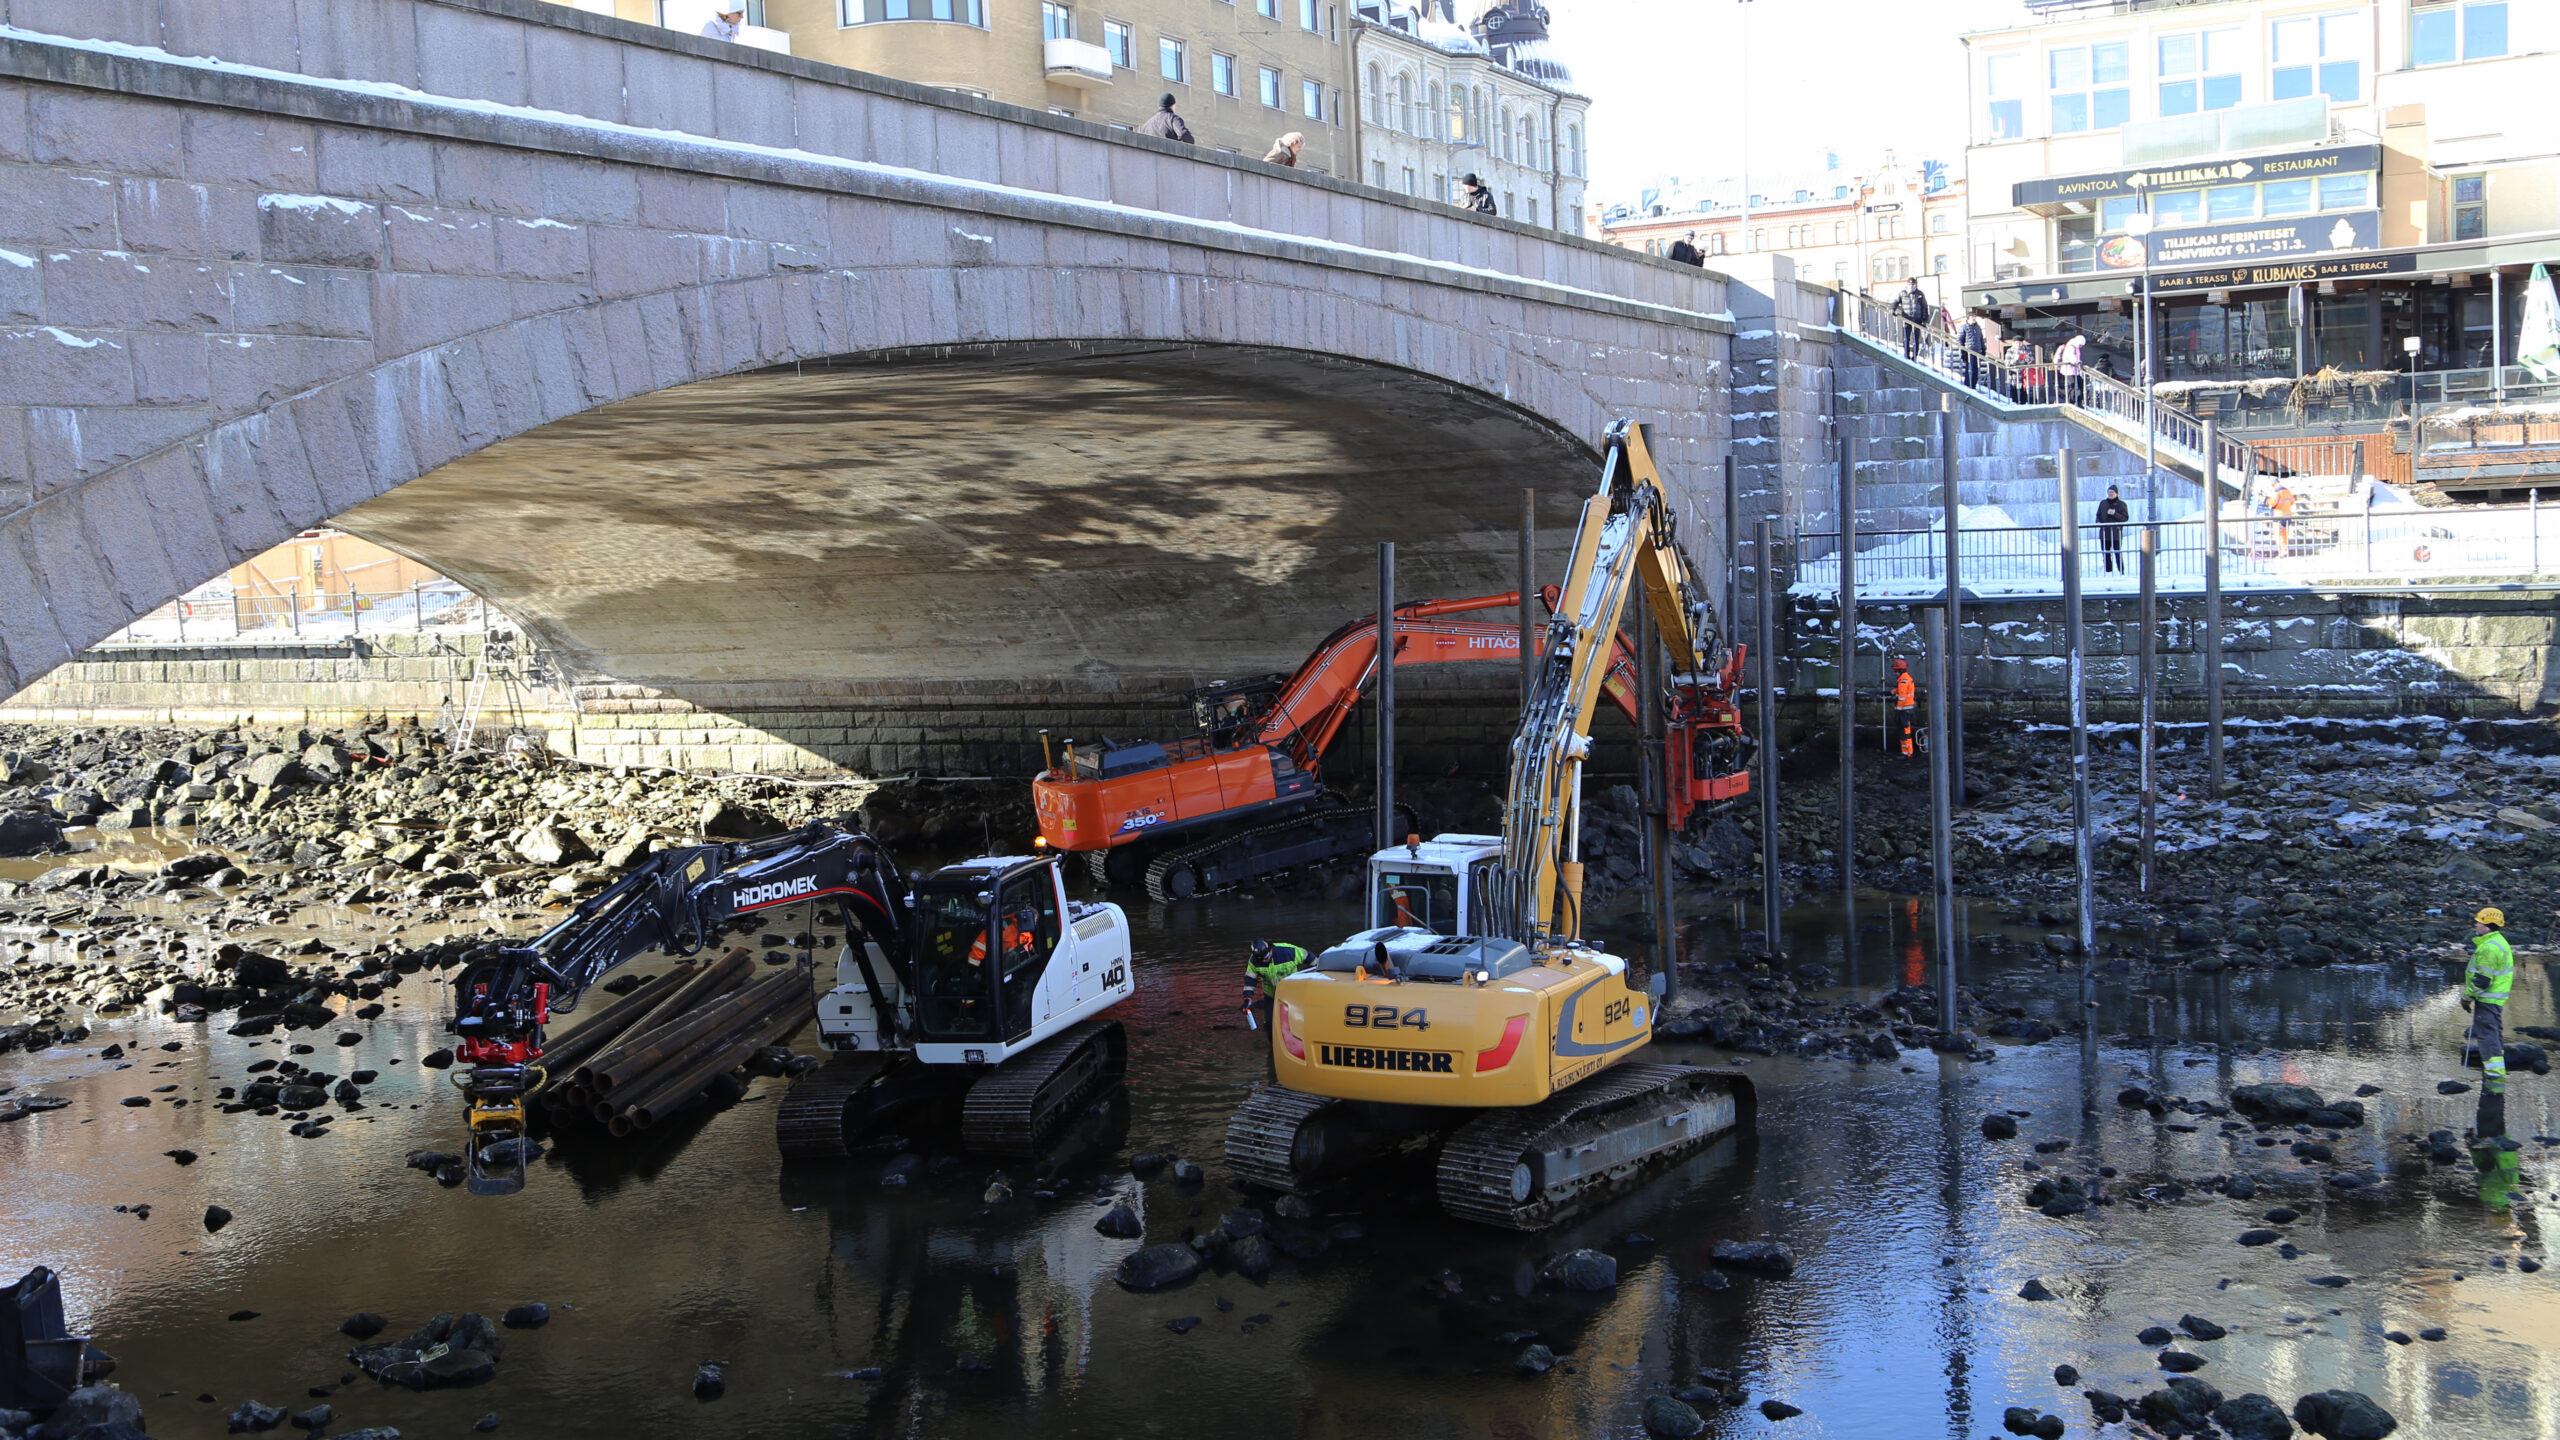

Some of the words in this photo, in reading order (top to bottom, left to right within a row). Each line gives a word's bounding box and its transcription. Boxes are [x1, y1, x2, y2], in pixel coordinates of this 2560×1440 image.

[2058, 180, 2118, 195] RAVINTOLA
[2149, 166, 2230, 186] TILLIKKA
[2264, 156, 2339, 173] RESTAURANT
[2163, 234, 2218, 249] TILLIKAN
[2221, 227, 2297, 244] PERINTEISET
[2158, 245, 2232, 261] BLINIVIIKOT
[2159, 277, 2184, 287] BAARI
[2186, 277, 2193, 285] &
[2195, 274, 2228, 284] TERASSI
[2252, 264, 2317, 283] KLUBIMIES
[2321, 265, 2338, 274] BAR
[2341, 264, 2348, 272] &
[2350, 261, 2388, 272] TERRACE
[1123, 814, 1157, 830] 350
[1101, 965, 1124, 991] 140
[1344, 1004, 1431, 1032] 924
[1605, 996, 1630, 1026] 924
[1321, 1045, 1454, 1073] LIEBHERR
